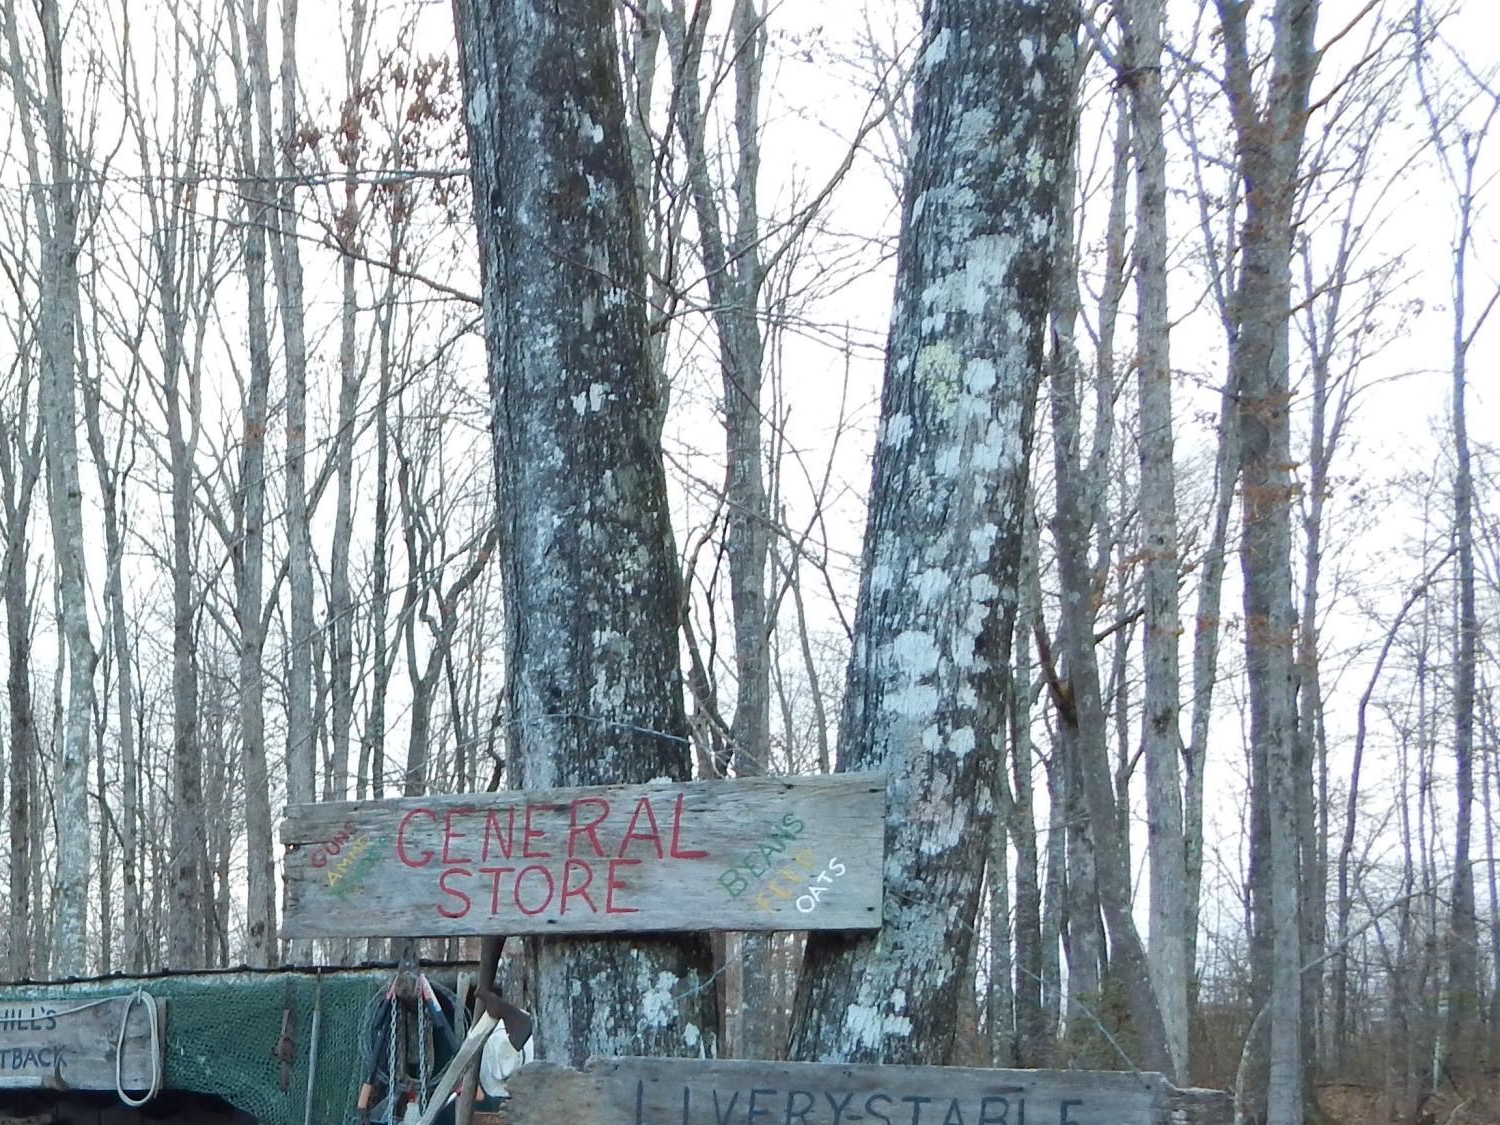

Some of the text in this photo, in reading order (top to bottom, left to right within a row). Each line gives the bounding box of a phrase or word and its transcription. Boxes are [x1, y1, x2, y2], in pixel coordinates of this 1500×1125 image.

[311, 821, 357, 868] GUNS
[399, 793, 709, 868] GENERAL
[718, 813, 804, 899] BEANS
[437, 858, 642, 919] STORE
[795, 857, 847, 913] OATS
